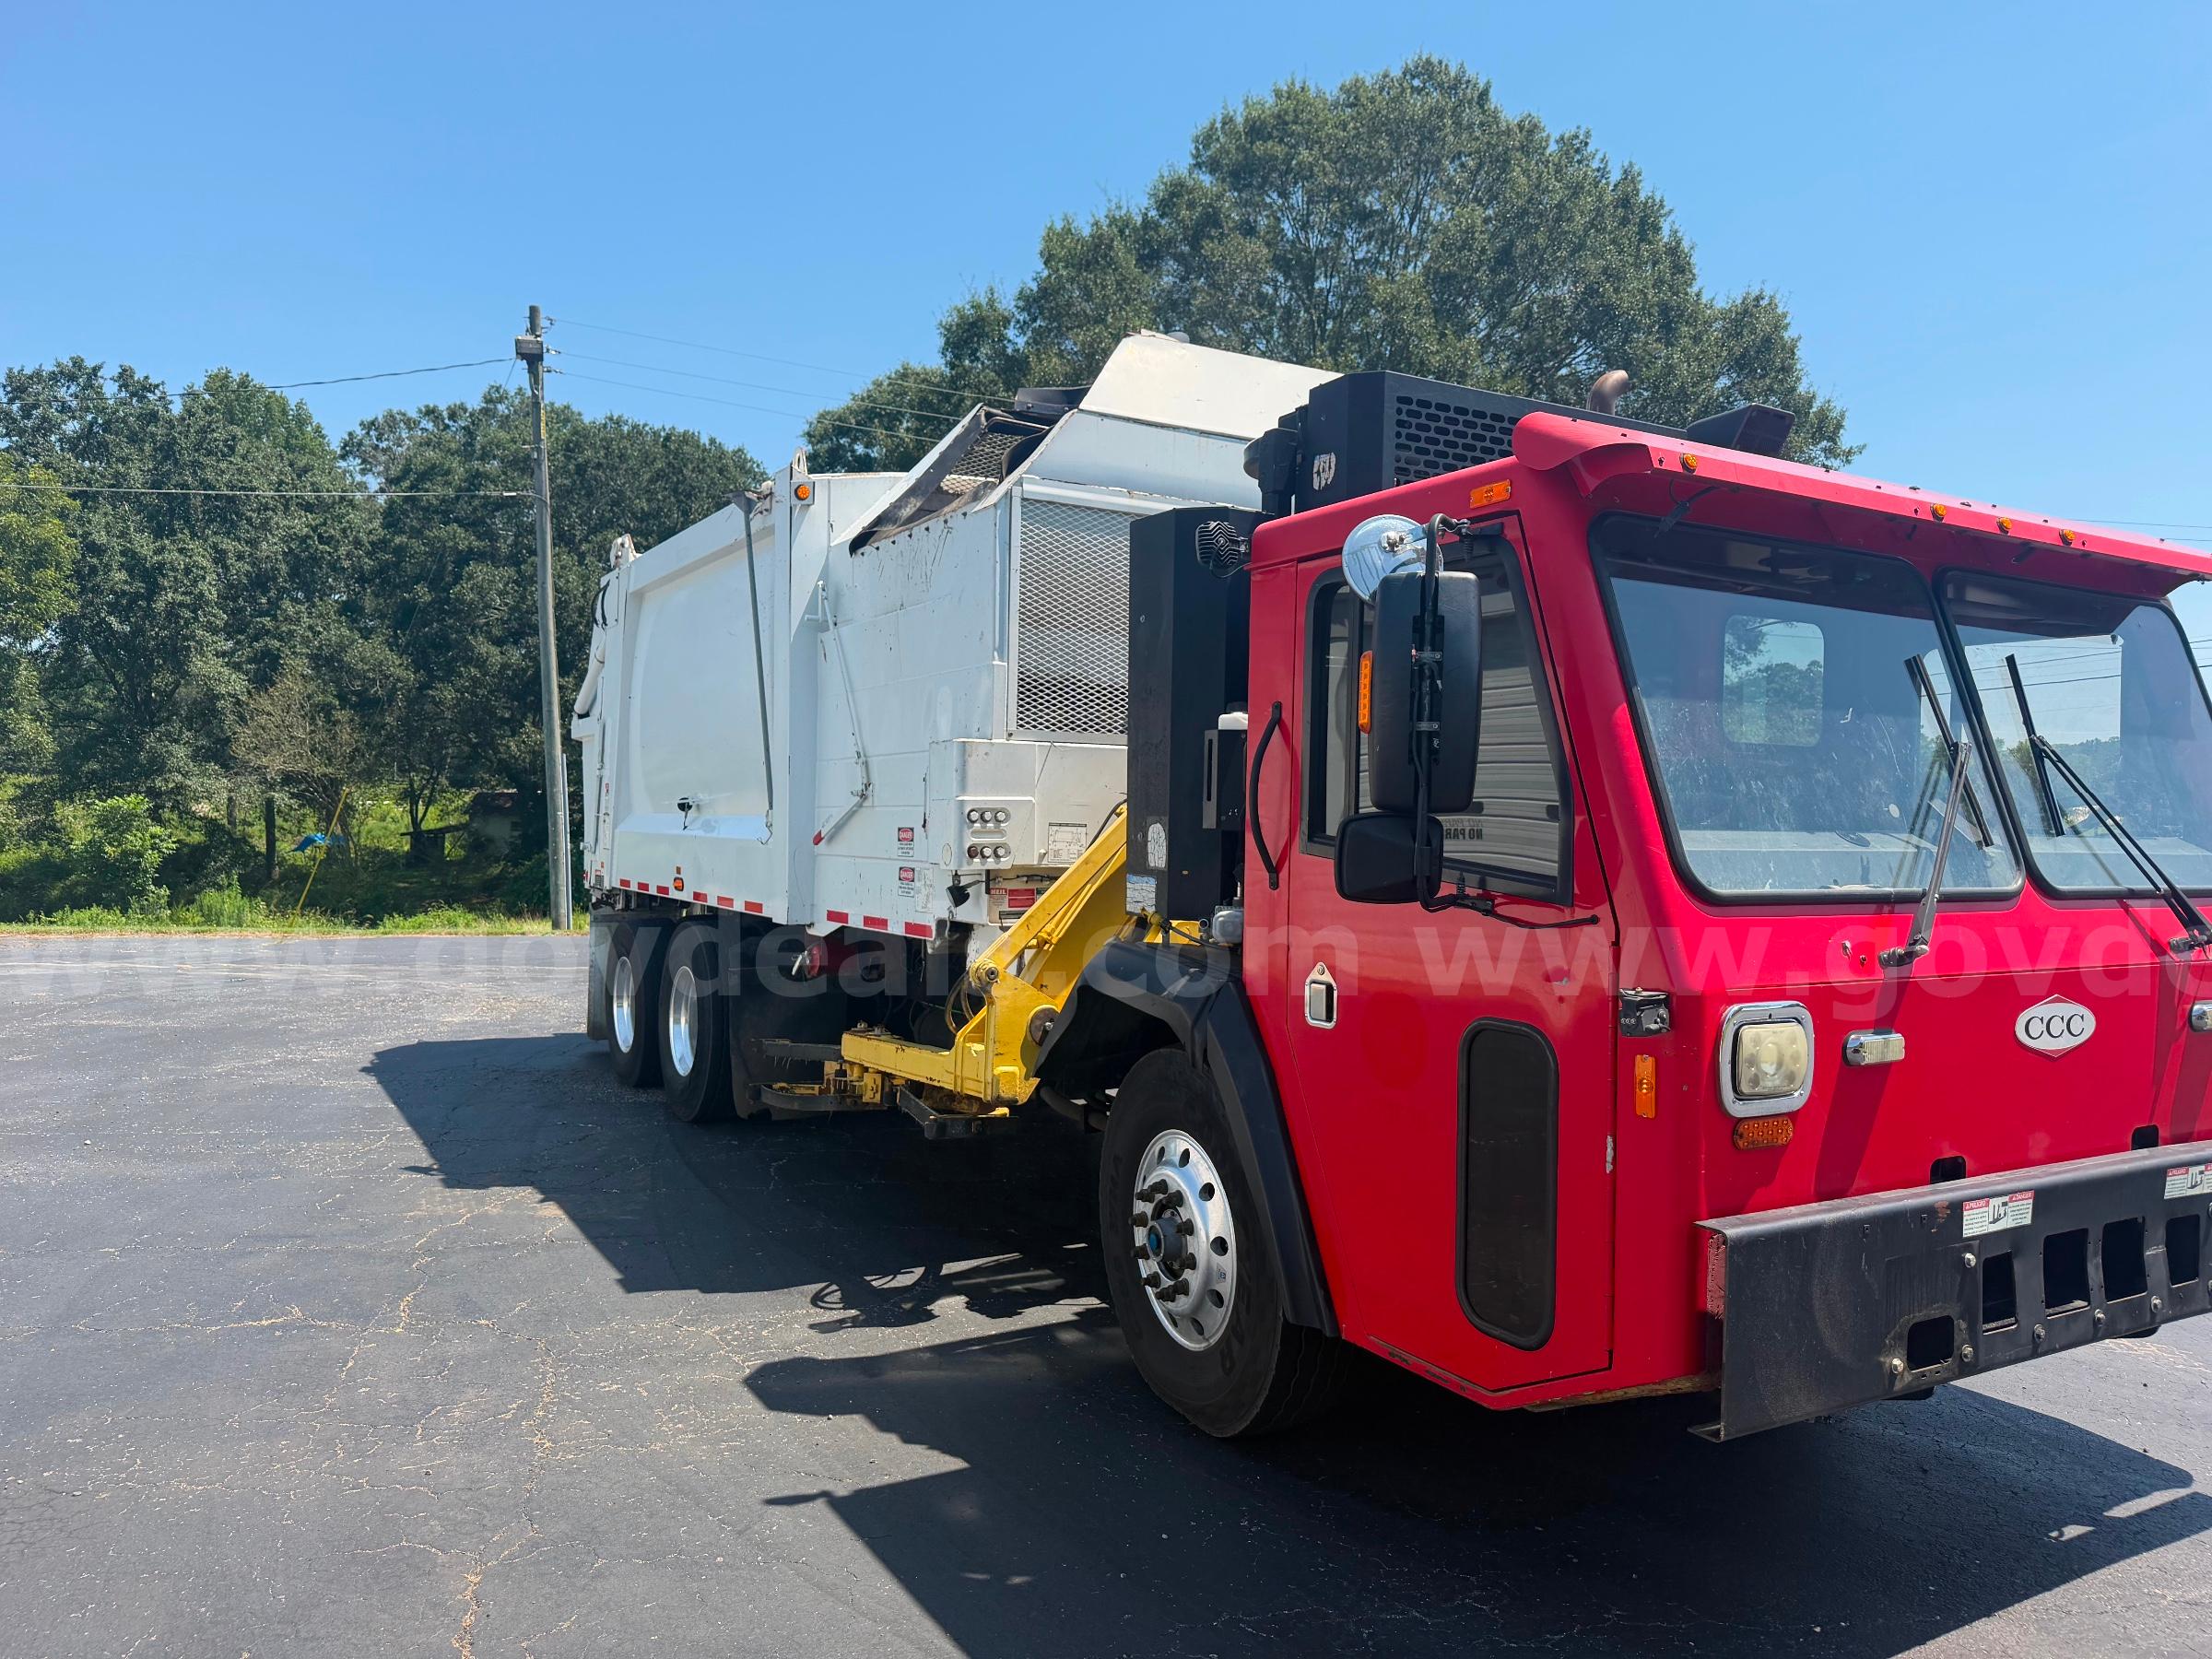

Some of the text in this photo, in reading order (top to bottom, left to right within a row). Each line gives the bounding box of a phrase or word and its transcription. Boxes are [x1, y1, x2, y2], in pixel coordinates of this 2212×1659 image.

[2025, 1013, 2085, 1040] CCC
[1969, 1192, 2032, 1209] PELIGRO DANGER
